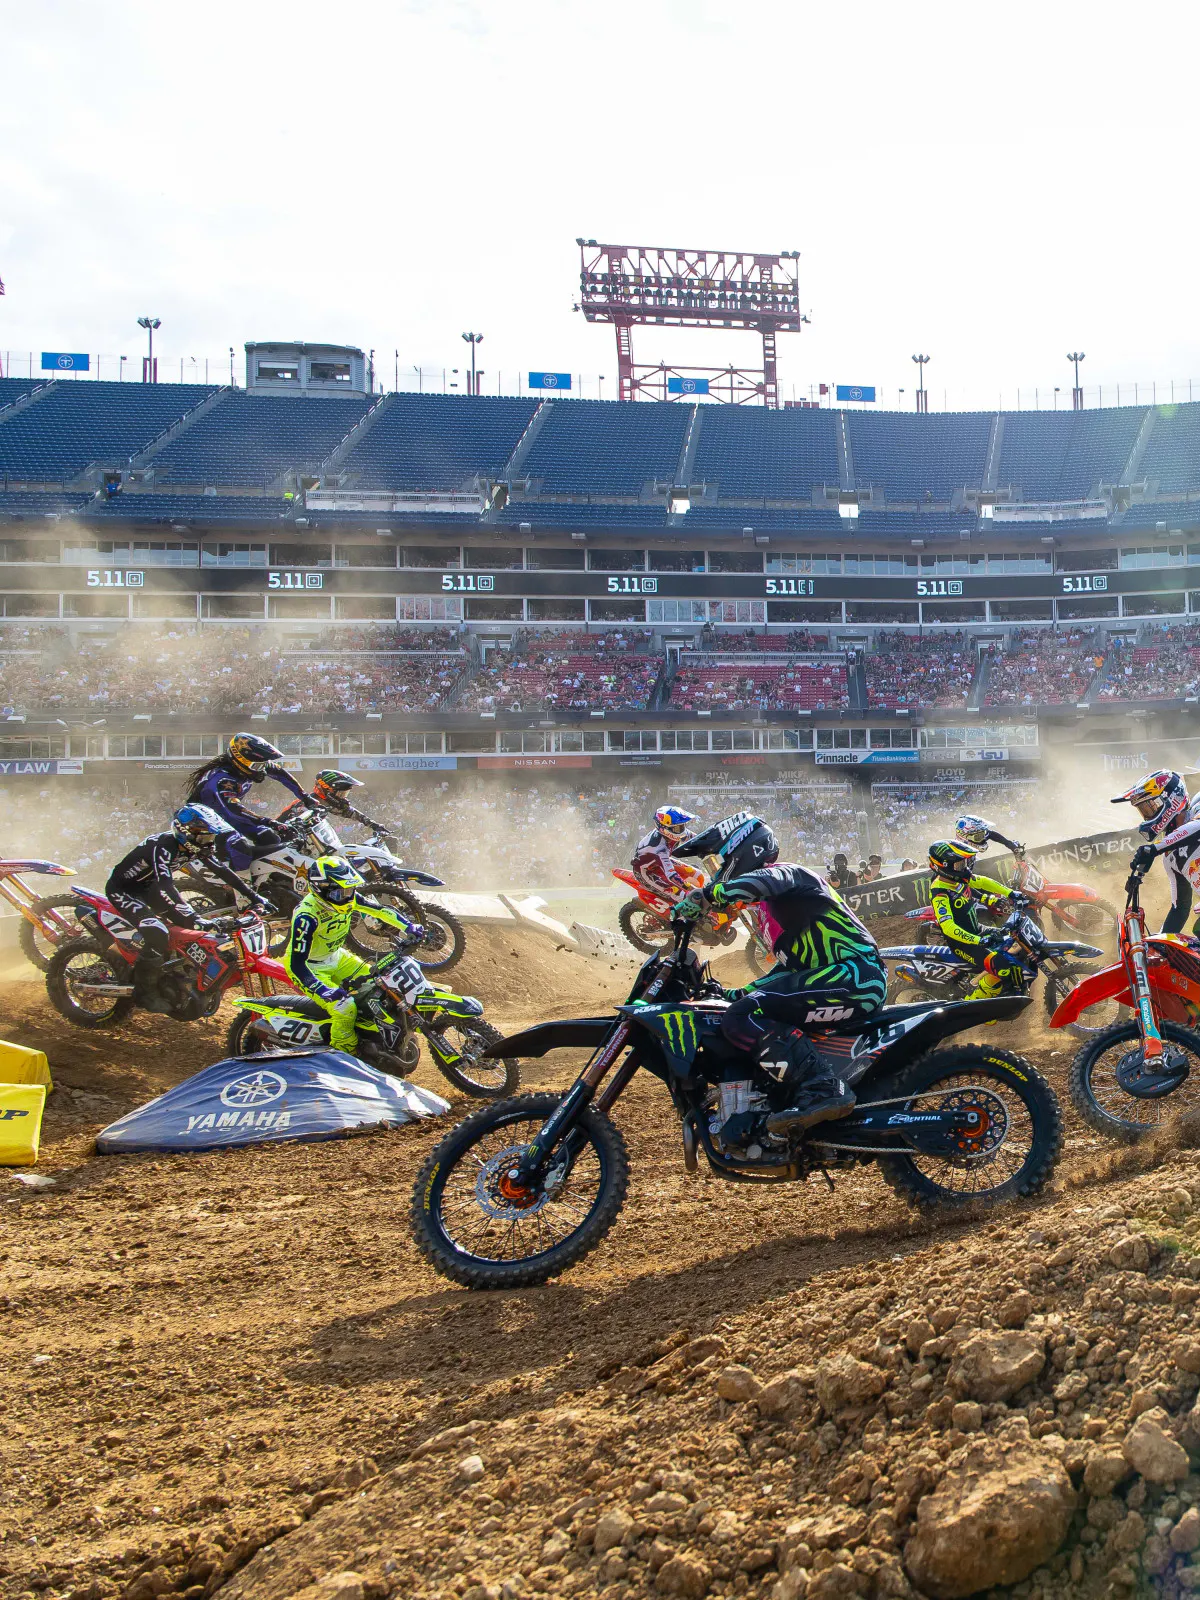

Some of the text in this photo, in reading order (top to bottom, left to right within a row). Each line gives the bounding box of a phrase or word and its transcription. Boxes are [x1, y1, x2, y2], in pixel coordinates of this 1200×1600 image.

[86, 570, 125, 587] 5.11
[268, 572, 304, 588] 5.11
[442, 575, 477, 590] 5.11
[607, 577, 639, 593] 5.11
[766, 578, 798, 594] 5.11
[1063, 576, 1092, 592] 5.11
[917, 580, 947, 595] 5.11
[378, 757, 440, 770] Gallagher
[721, 755, 765, 765] verizon
[817, 753, 859, 763] Pinnacle
[15, 763, 50, 773] LAW
[936, 768, 966, 778] FLOYD
[804, 1006, 855, 1023] KTM
[278, 1020, 313, 1044] 20
[988, 1057, 1029, 1083] DUNLOP
[186, 1111, 292, 1131] YAMAHA
[424, 1162, 441, 1211] DUNLOP
